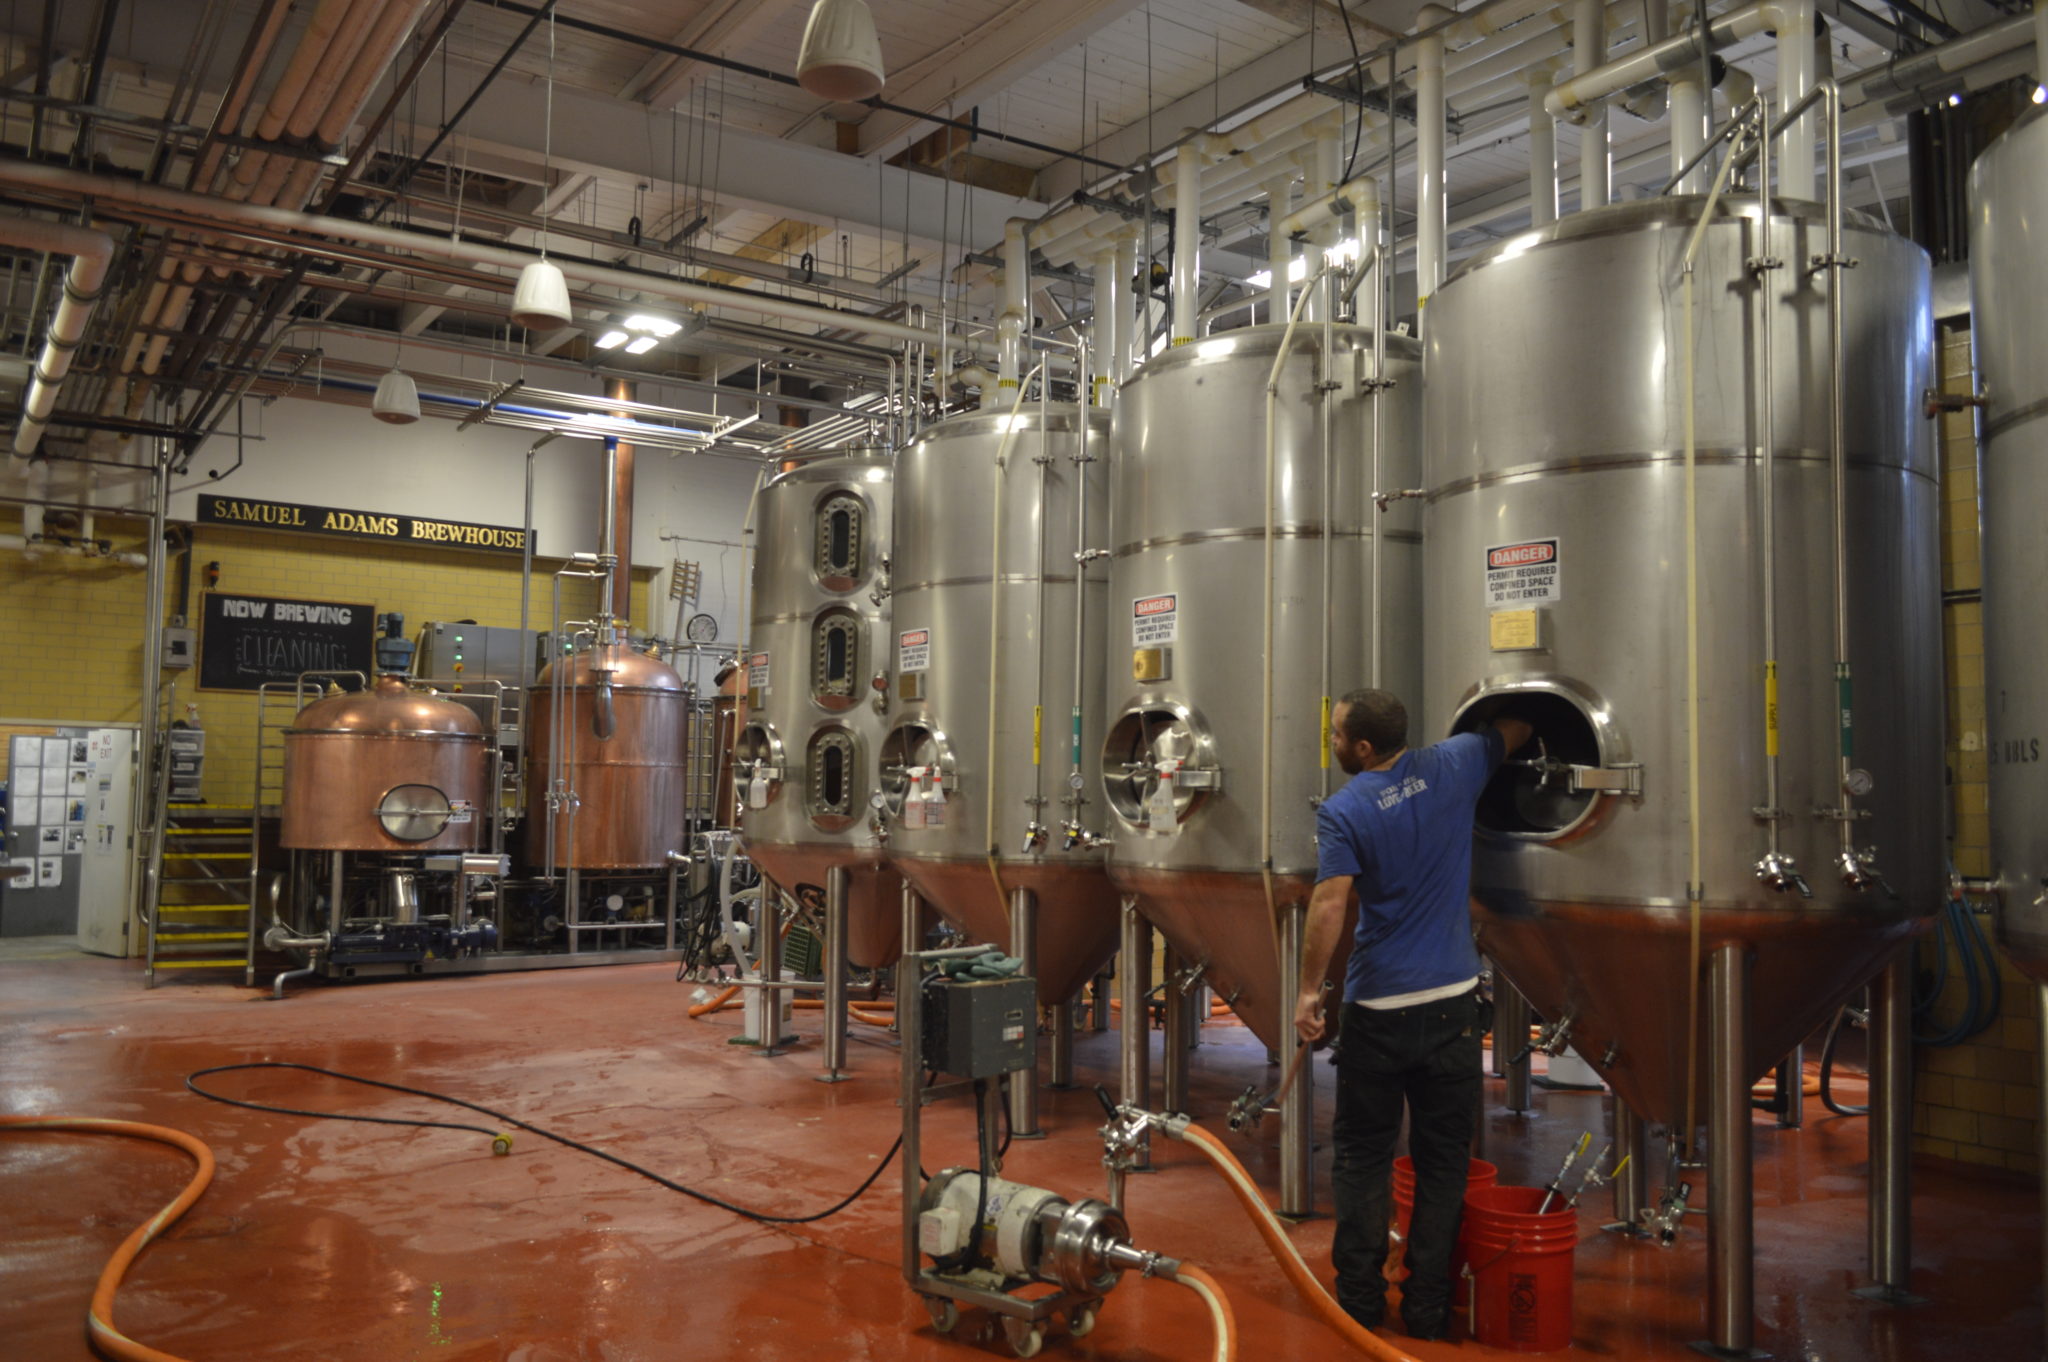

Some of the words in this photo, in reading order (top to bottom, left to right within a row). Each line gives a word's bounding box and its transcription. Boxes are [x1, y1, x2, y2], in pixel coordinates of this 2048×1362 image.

[214, 500, 306, 527] SAMUEL
[323, 512, 399, 537] ADAMS
[411, 520, 527, 550] BREWHOUSE
[1494, 546, 1548, 564] DANGER
[1488, 570, 1514, 581] PERMIT
[1516, 565, 1556, 577] REQUIRED
[1490, 579, 1526, 591] CONFINED
[1528, 576, 1554, 587] SPACE
[1495, 592, 1505, 602] DO
[1507, 590, 1520, 600] NOT
[1523, 588, 1548, 598] ENTER
[223, 599, 268, 618] NOW
[274, 603, 352, 626] BREWING
[1139, 599, 1170, 611] DANGER
[103, 735, 111, 745] NO
[100, 748, 112, 759] EXIT
